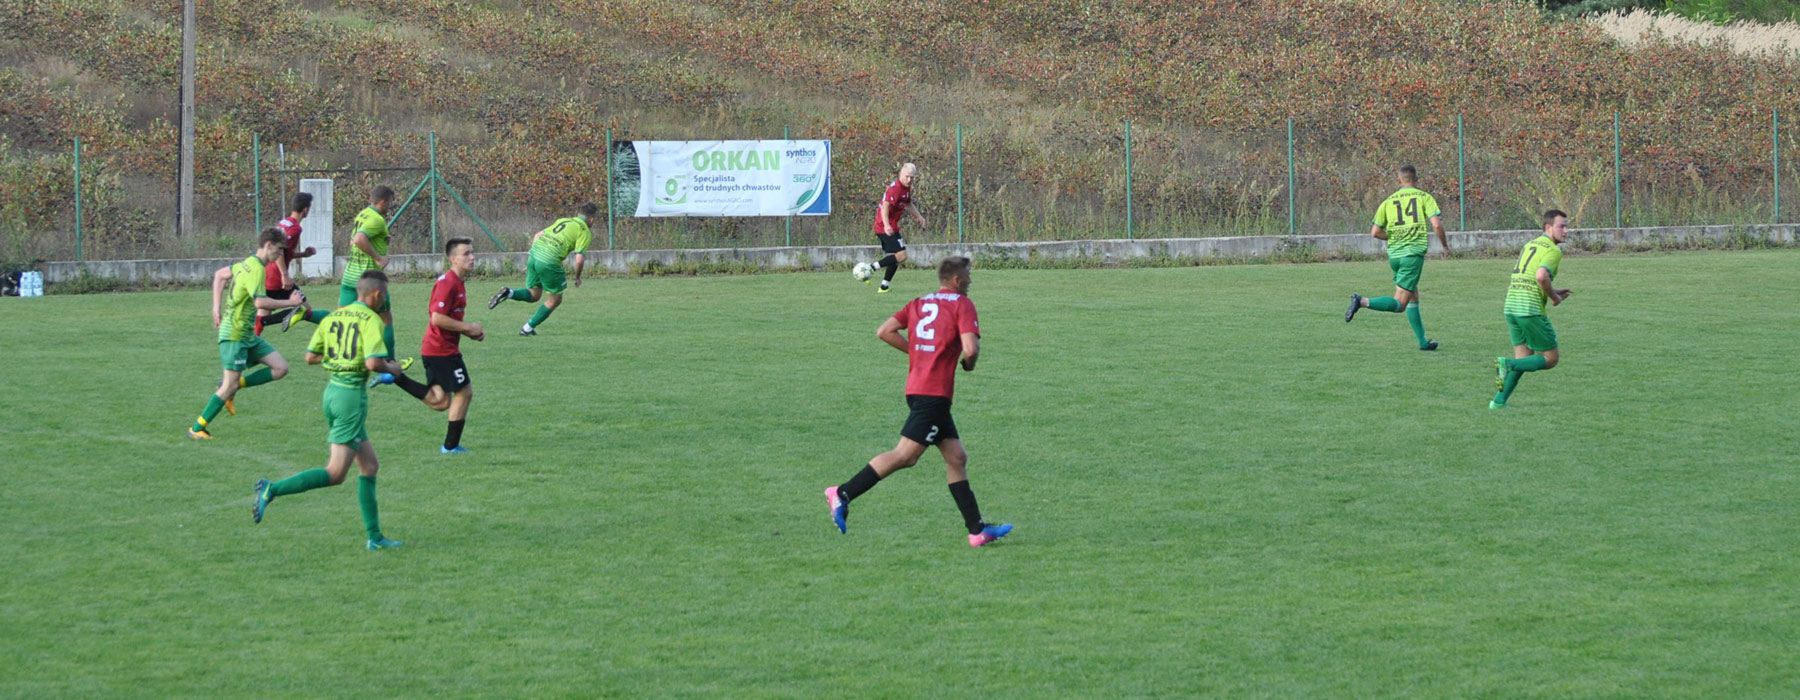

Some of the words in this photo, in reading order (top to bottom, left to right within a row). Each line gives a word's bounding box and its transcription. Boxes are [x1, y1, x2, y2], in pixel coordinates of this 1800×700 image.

[692, 150, 780, 172] ORKAN
[785, 147, 816, 158] synthos
[693, 174, 736, 184] Specjalista
[693, 184, 704, 192] od
[705, 184, 740, 193] trudnych
[742, 184, 781, 192] chwastów
[1393, 198, 1419, 226] 14
[552, 220, 572, 235] 6
[915, 302, 939, 340] 2
[328, 321, 360, 360] 30
[453, 367, 466, 384] 5
[925, 424, 939, 442] 2
